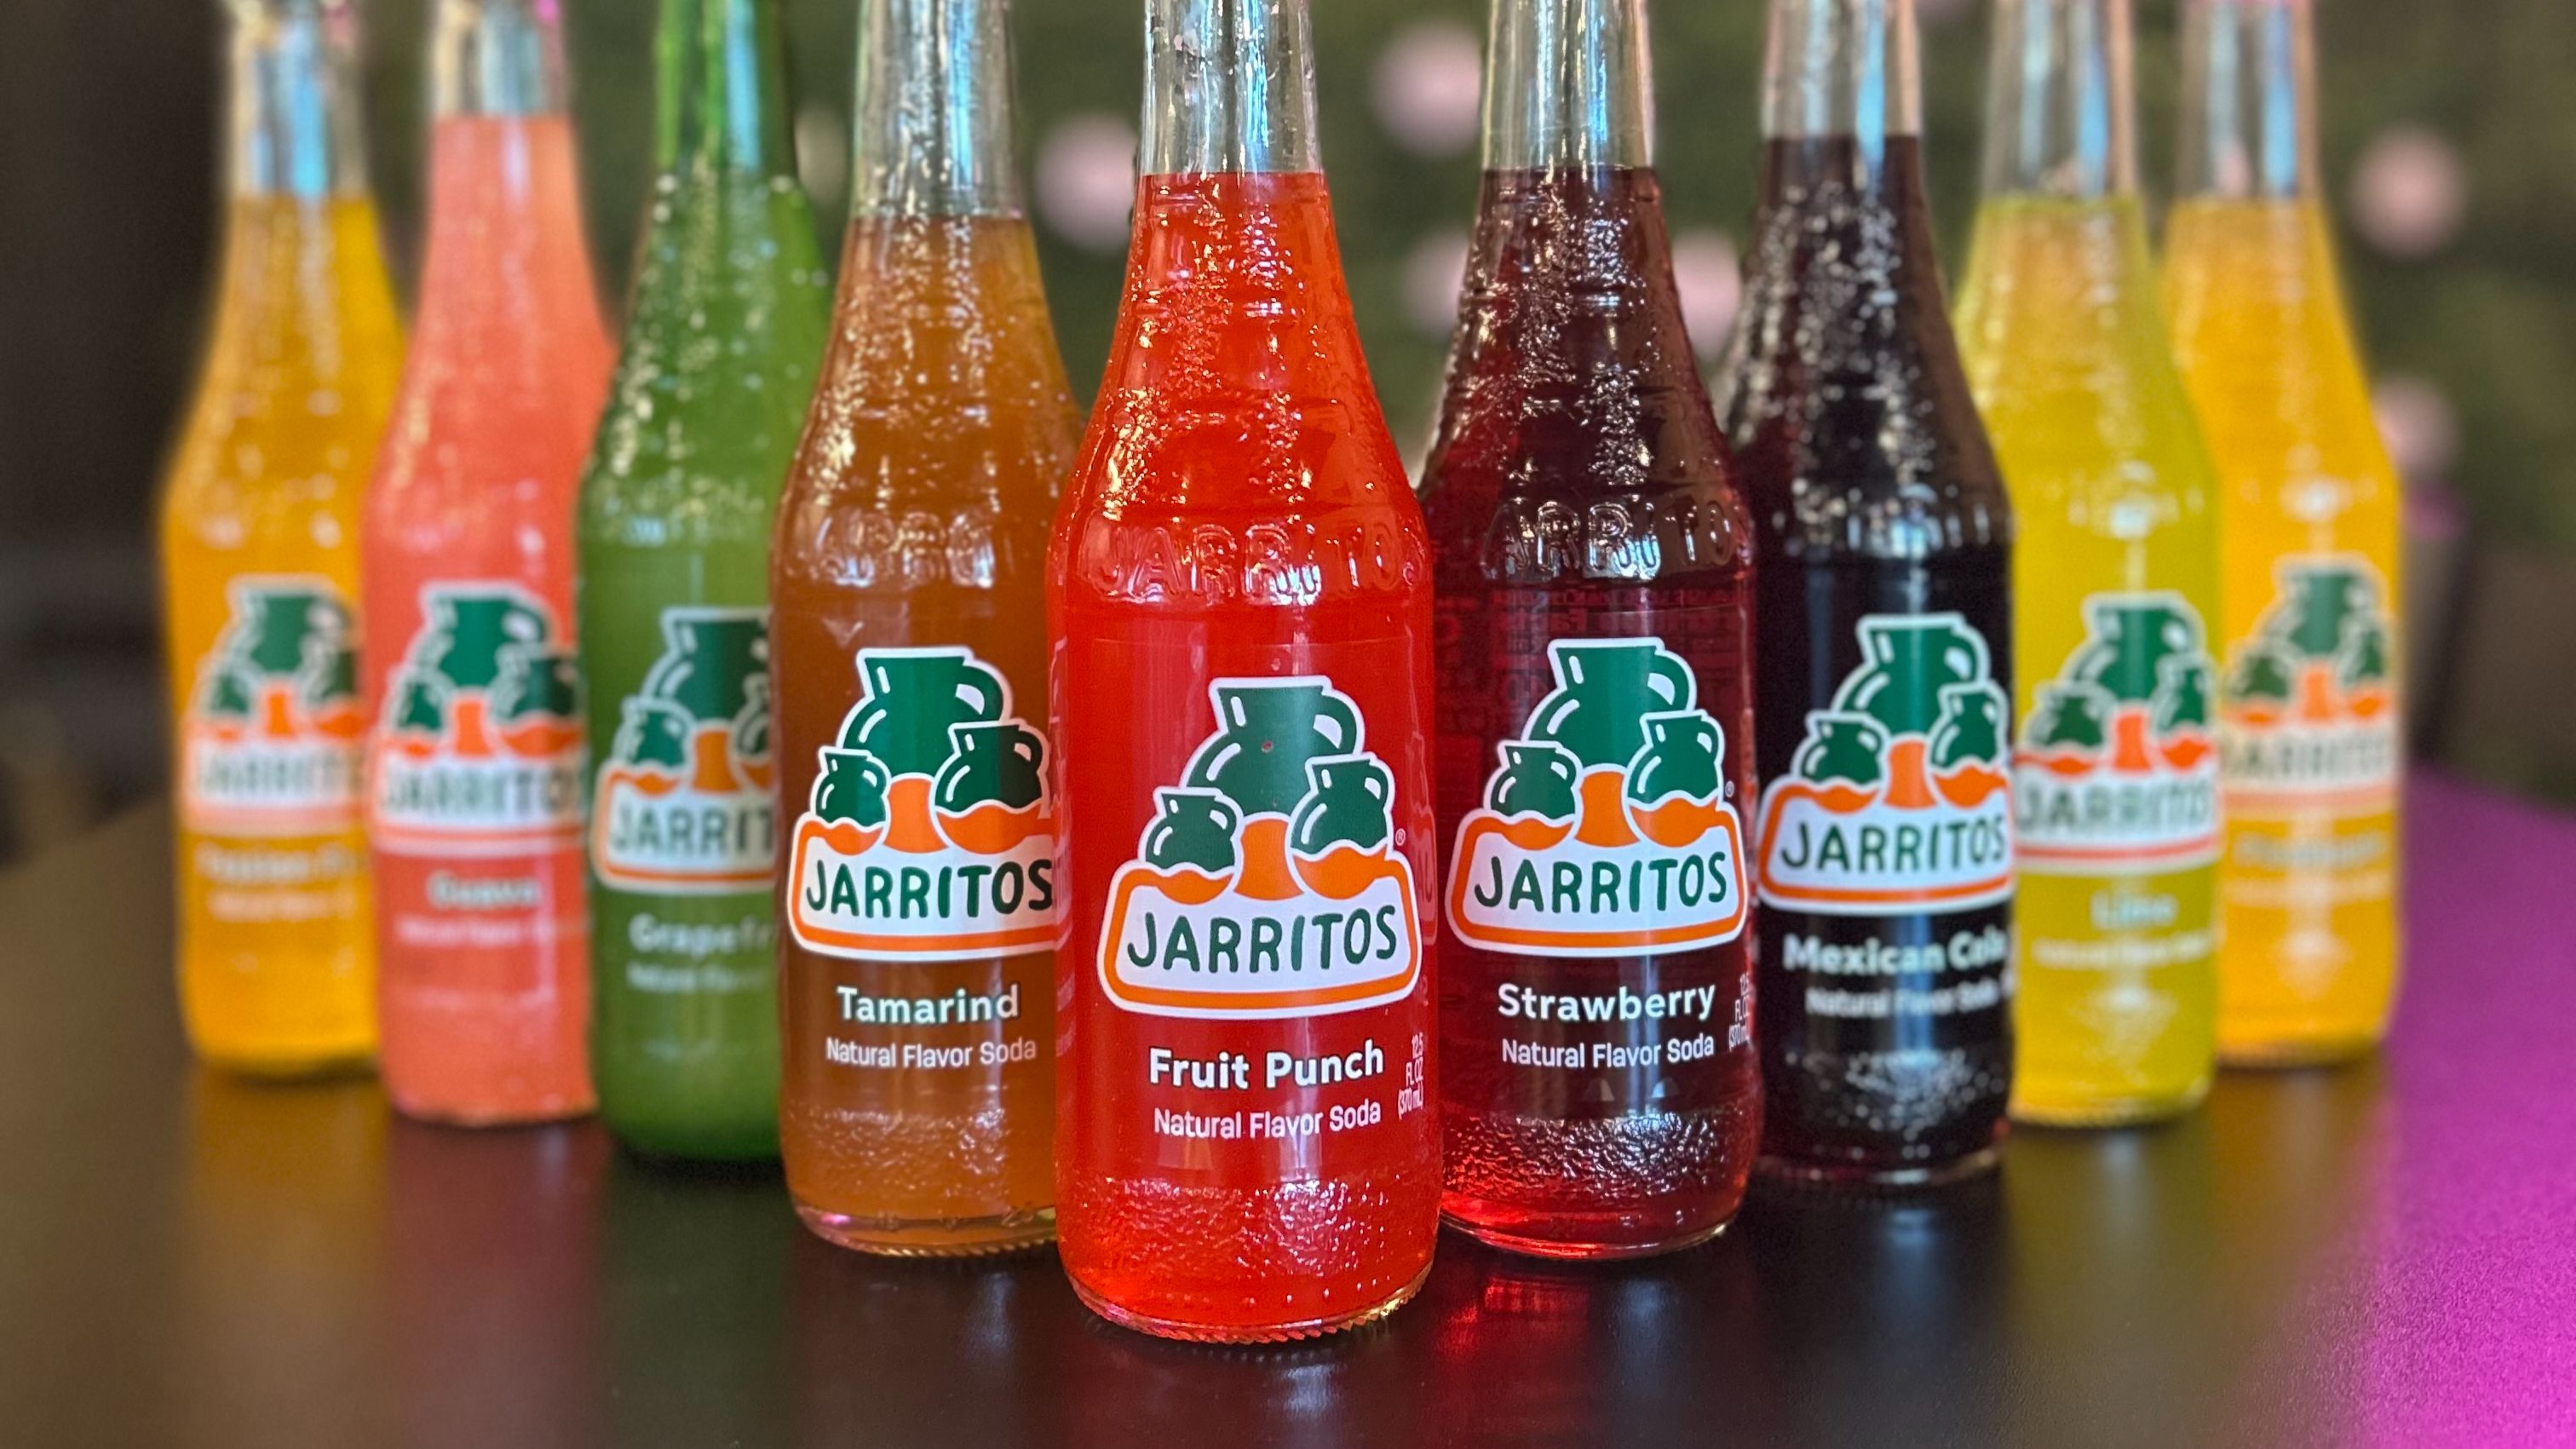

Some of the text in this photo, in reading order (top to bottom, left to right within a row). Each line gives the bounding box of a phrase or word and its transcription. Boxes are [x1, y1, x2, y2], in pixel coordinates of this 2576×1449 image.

[1781, 816, 2004, 872] JARRITOS
[806, 860, 1054, 919] JARRITOS
[1475, 852, 1727, 913] JARRITOS
[1127, 906, 1397, 973] JARRITOS
[1783, 933, 1946, 975] Mexican
[836, 984, 1020, 1025] Tamarind
[1498, 982, 1716, 1022] Strawberry
[1805, 986, 1890, 1018] Natural
[826, 1037, 1037, 1070] Natural Flavor Soda
[1149, 1038, 1384, 1090] Fruit Punch
[1502, 1032, 1715, 1068] Natural Flavor Soda
[1154, 1099, 1382, 1140] Natural Flavor Soda
